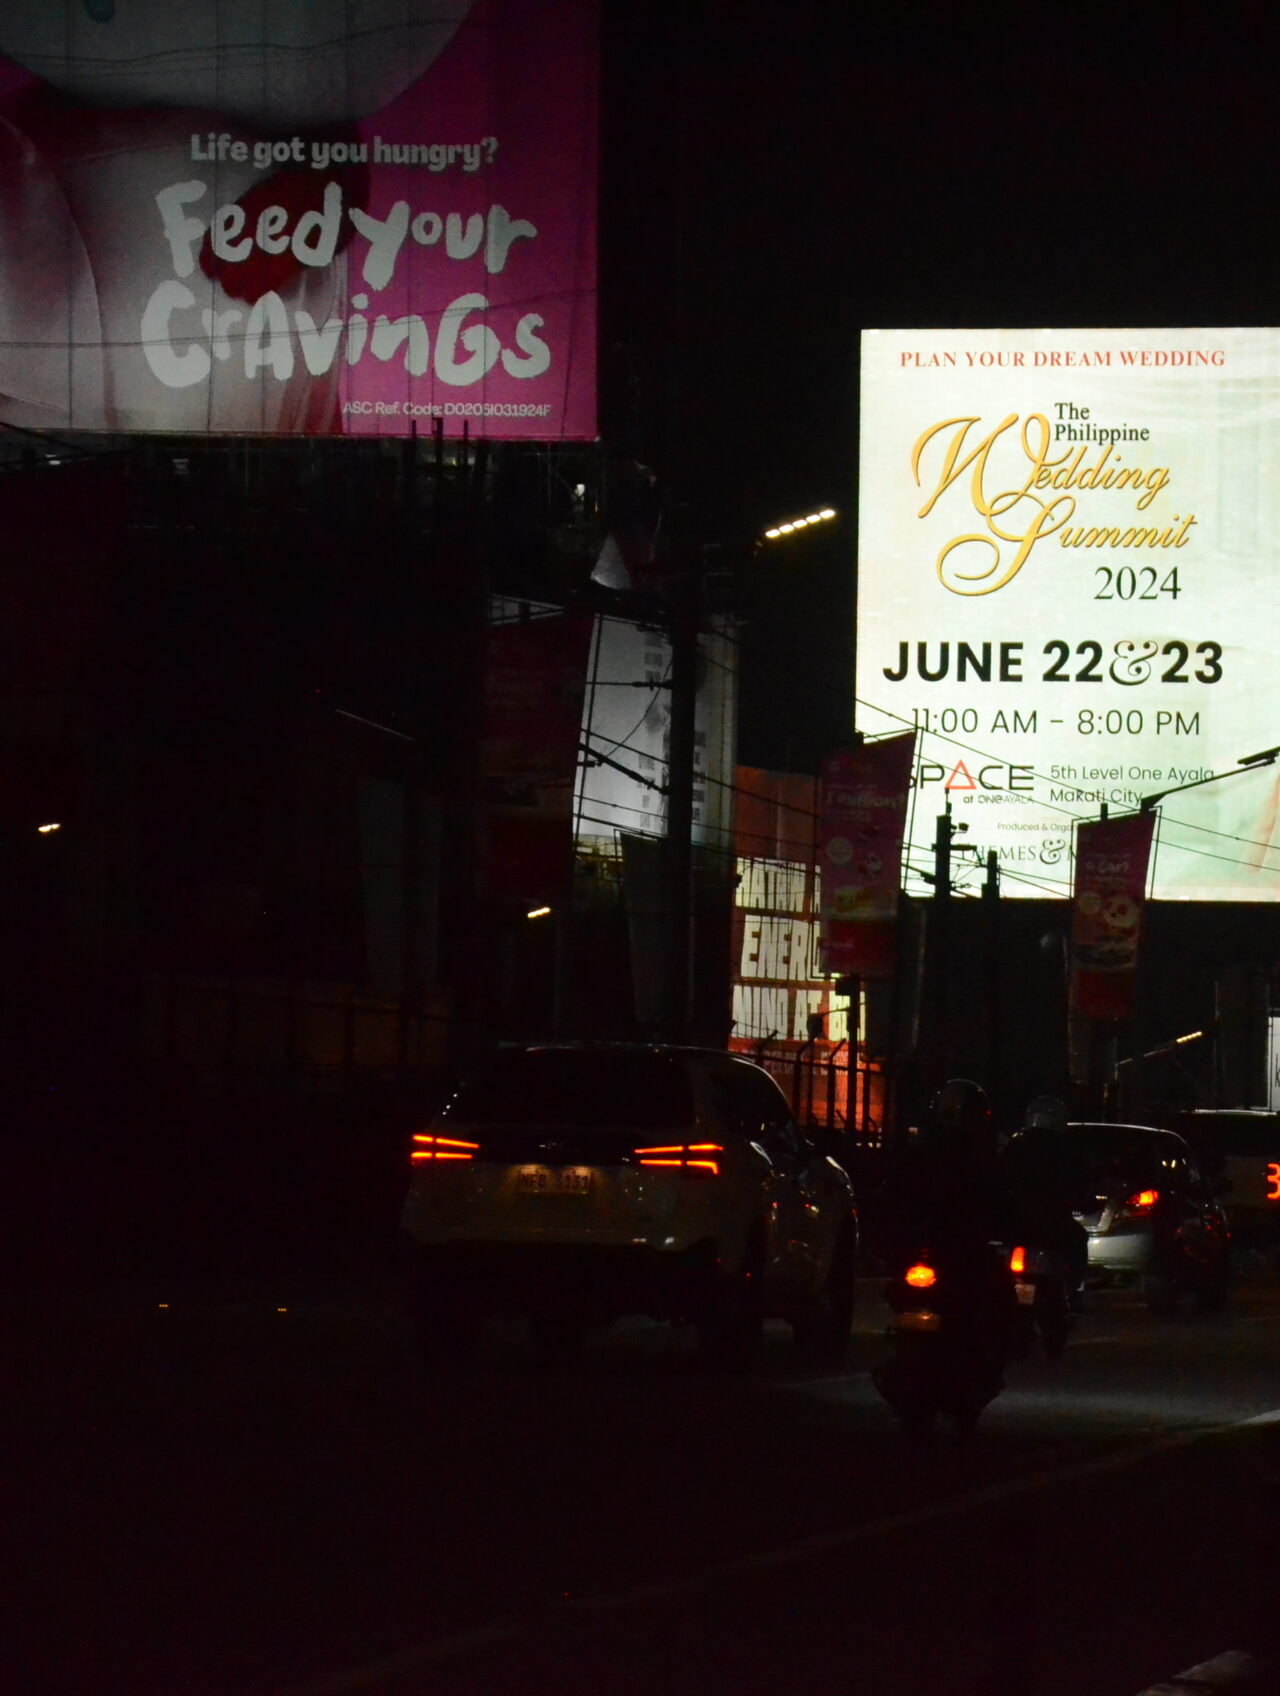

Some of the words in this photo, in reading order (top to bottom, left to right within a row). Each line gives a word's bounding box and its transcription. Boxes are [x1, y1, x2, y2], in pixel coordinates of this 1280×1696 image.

[190, 133, 248, 162] Life
[253, 136, 306, 169] got
[311, 139, 367, 169] you
[373, 135, 499, 172] hungry?
[154, 179, 343, 278] Feed
[348, 200, 538, 291] your
[900, 351, 957, 368] PLAN
[964, 351, 1025, 367] YOUR
[1033, 350, 1112, 367] DREAM
[1120, 350, 1226, 366] WEDDING
[342, 401, 372, 414] ASC
[402, 402, 442, 415] Code:
[1054, 402, 1090, 421] The
[1054, 423, 1150, 446] Philippine
[910, 412, 1170, 519] Wedding
[936, 491, 1198, 597] Summit
[1093, 566, 1182, 600] 2024
[883, 640, 1024, 683] JUNE
[911, 708, 979, 734] 11:00
[990, 709, 1038, 734] AM
[1077, 709, 1144, 736] 8:00
[1156, 711, 1201, 736] PM
[1050, 765, 1077, 779] 5th
[1082, 766, 1123, 780] Level
[1128, 767, 1162, 780] One
[1167, 766, 1215, 784] Ayala
[963, 794, 974, 804] at
[1050, 788, 1106, 803] Makati
[1110, 788, 1144, 806] City
[997, 822, 1040, 831] Produced
[1050, 823, 1077, 833] Orga
[740, 914, 842, 982] ENERG
[731, 985, 789, 1040] MIND
